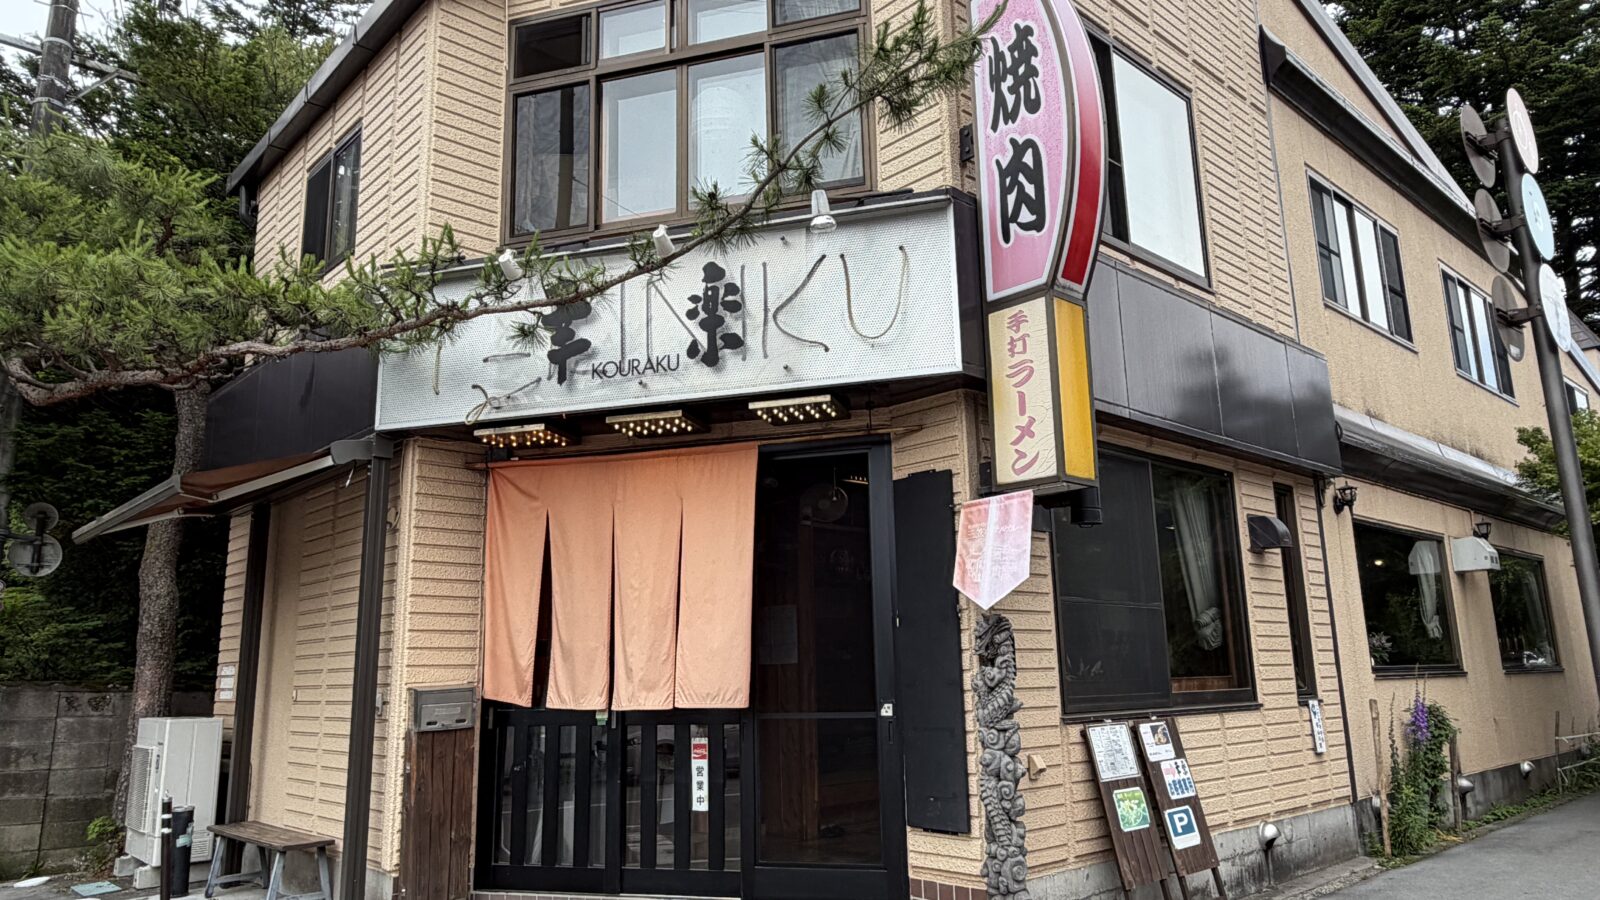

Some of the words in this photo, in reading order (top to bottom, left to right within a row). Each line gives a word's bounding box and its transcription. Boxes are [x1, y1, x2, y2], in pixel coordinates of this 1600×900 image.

[988, 23, 1047, 244] 焼肉
[592, 353, 680, 380] KOURAKU
[1006, 309, 1040, 476] 手打ラーメン
[695, 765, 705, 806] 営業中
[1173, 812, 1189, 833] P
